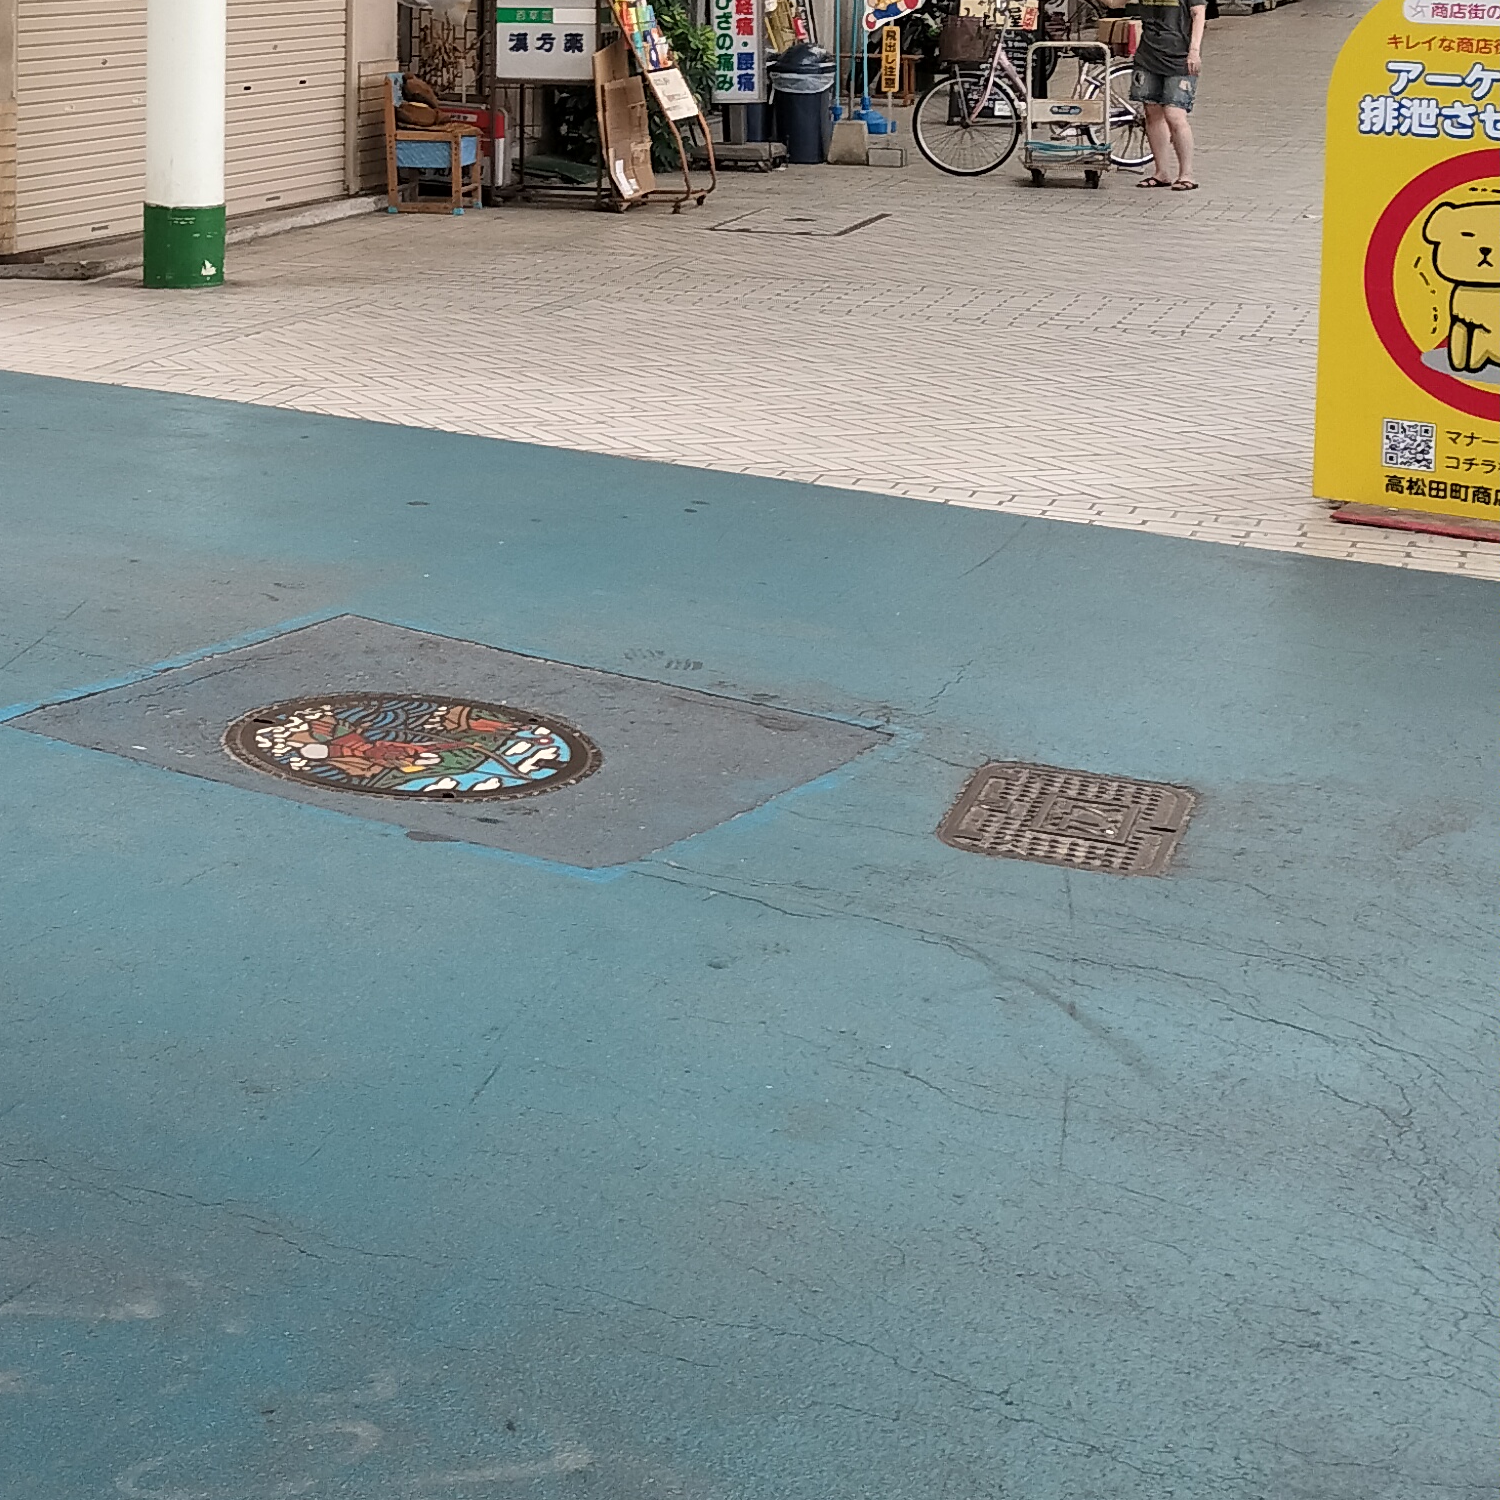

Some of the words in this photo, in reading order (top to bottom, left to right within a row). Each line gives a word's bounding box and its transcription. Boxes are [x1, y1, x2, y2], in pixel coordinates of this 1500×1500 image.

[508, 32, 585, 54] 漢方薬
[1385, 60, 1500, 101] アーケ
[1444, 455, 1500, 475] コチラ
